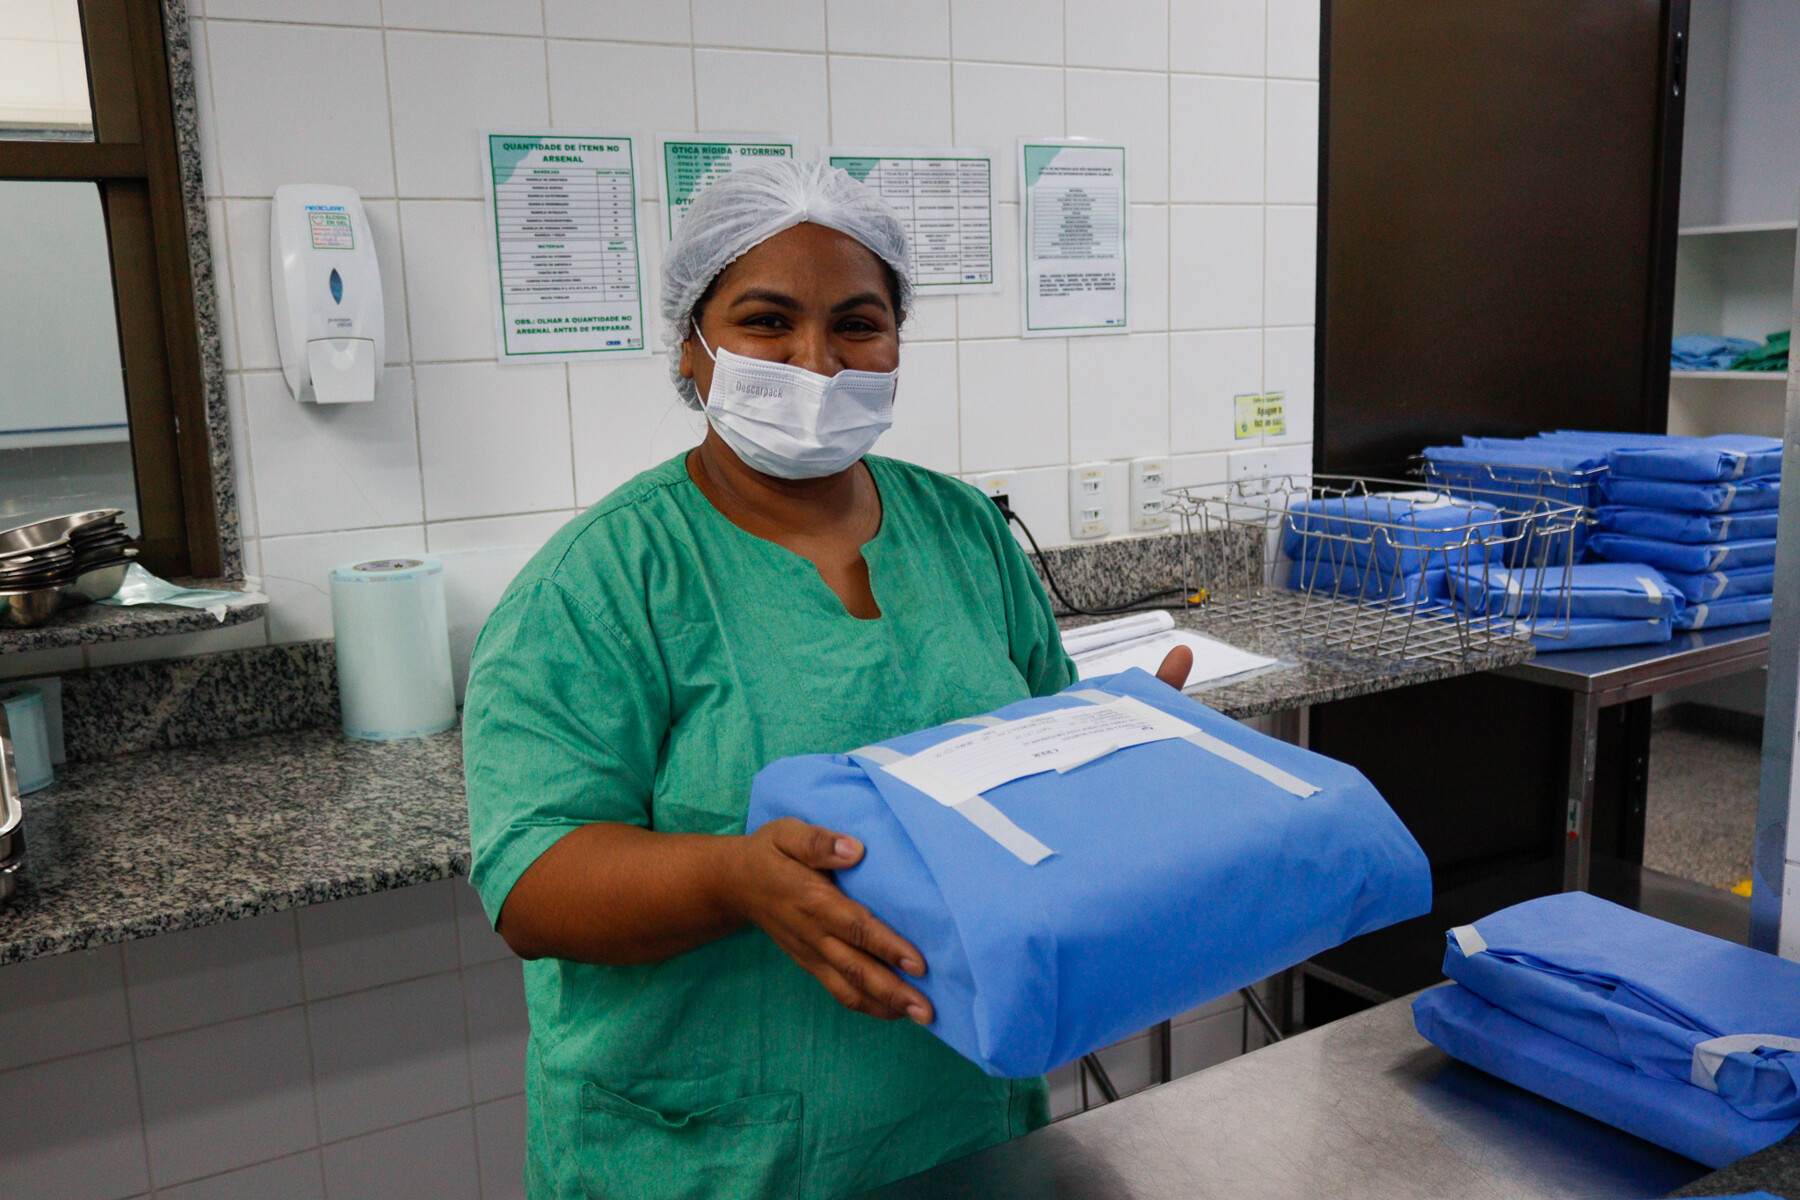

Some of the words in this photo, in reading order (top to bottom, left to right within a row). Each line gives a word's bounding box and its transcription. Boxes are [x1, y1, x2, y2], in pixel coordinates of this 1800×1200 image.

[503, 143, 562, 151] QUANTIDADE
[578, 143, 605, 152] ÍTENS
[671, 146, 700, 154] ÓTICA
[702, 146, 733, 154] RÍGIDA
[740, 148, 786, 156] OTORRINO
[542, 155, 584, 163] ARSENAL
[537, 317, 563, 325] OLHAR
[572, 315, 619, 324] QUANTIDADE
[516, 327, 552, 335] ARSENAL
[553, 326, 578, 334] ANTES
[592, 324, 633, 332] PREPARAR.
[736, 380, 783, 398] Descarpack
